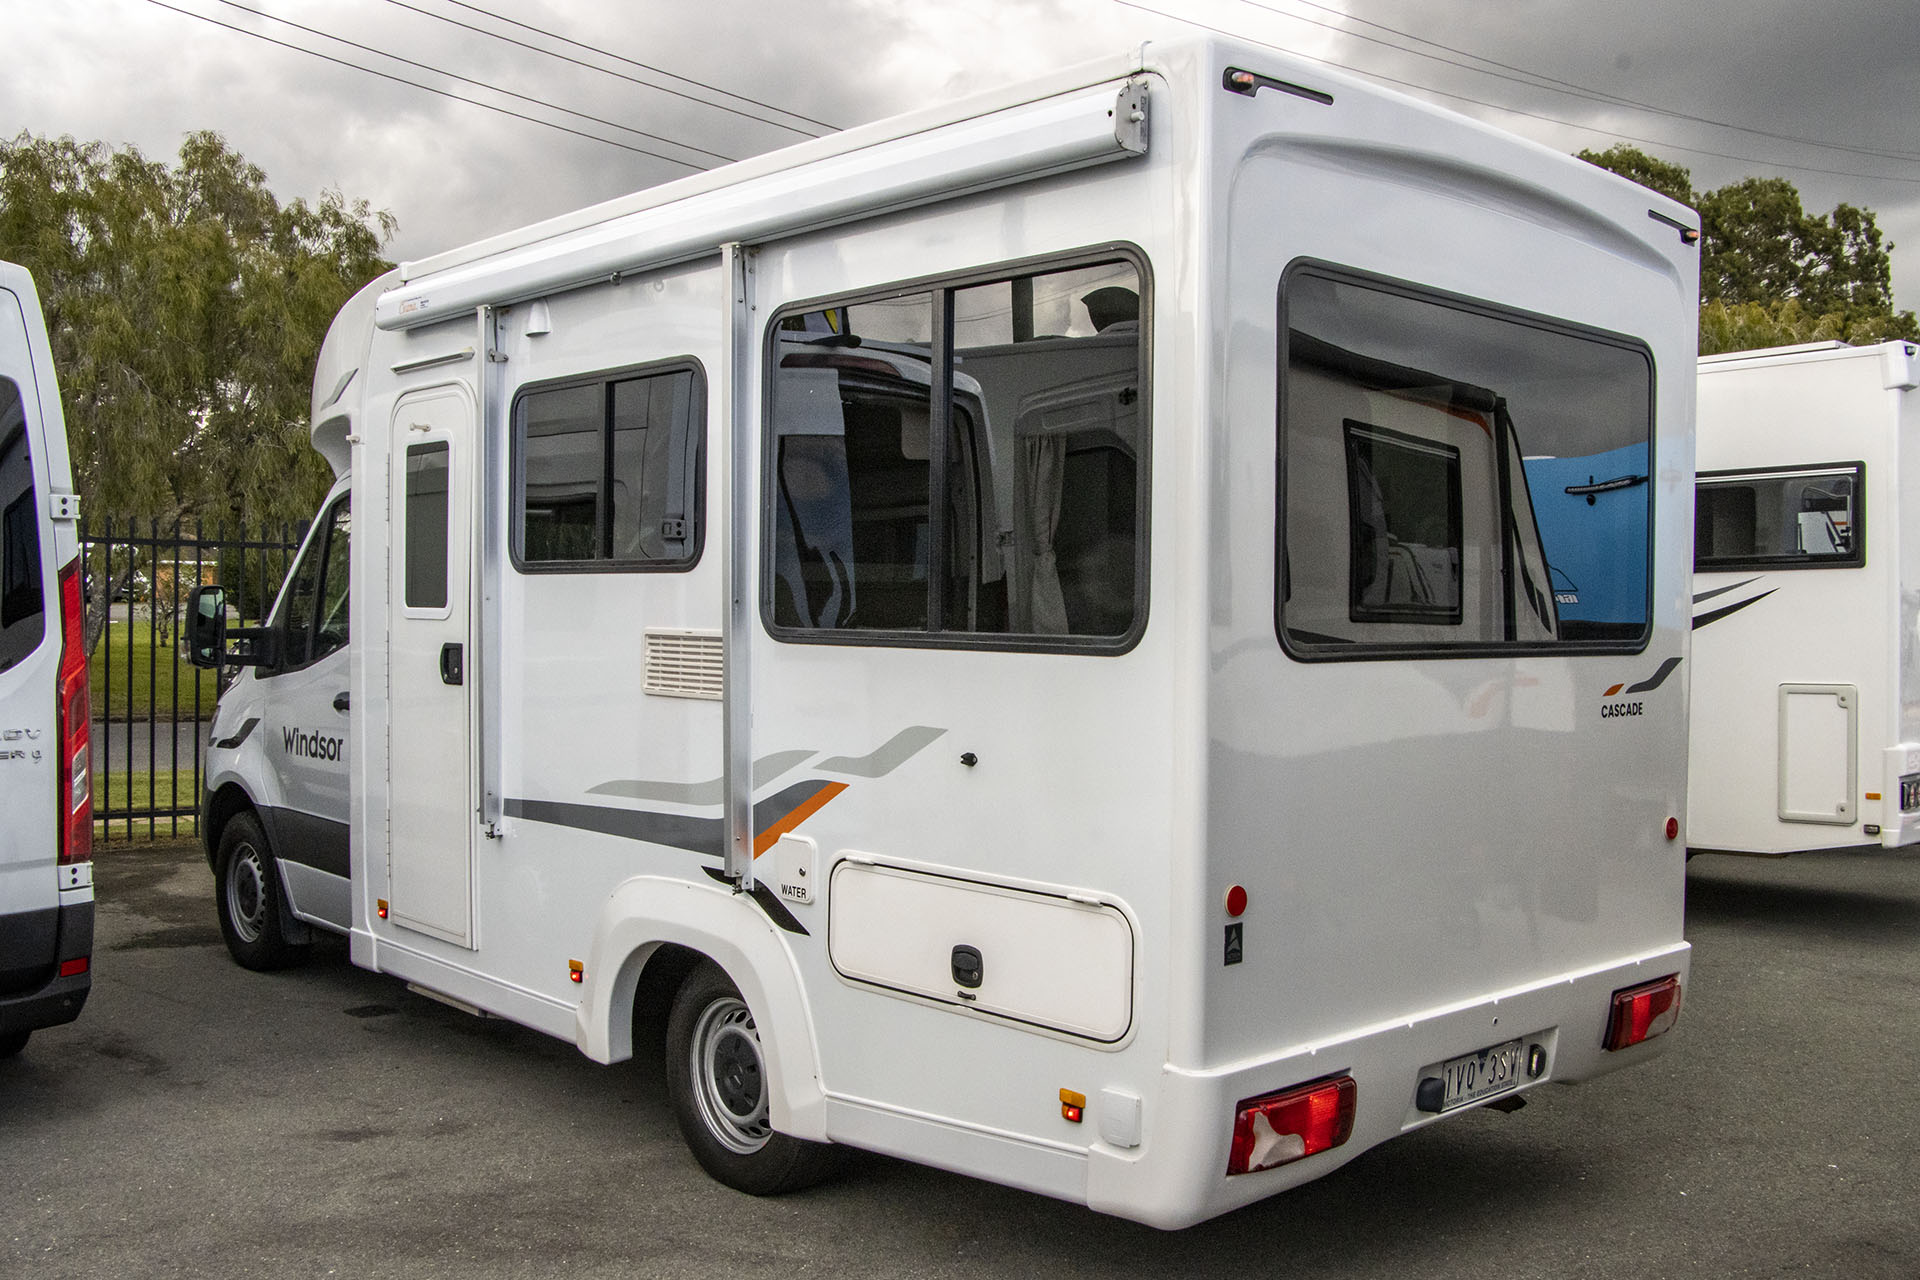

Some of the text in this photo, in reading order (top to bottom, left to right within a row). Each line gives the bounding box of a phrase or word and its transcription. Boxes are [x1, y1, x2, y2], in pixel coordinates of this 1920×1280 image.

[1601, 702, 1643, 719] CASCADE
[283, 726, 344, 762] Windsor
[781, 883, 807, 899] WATER
